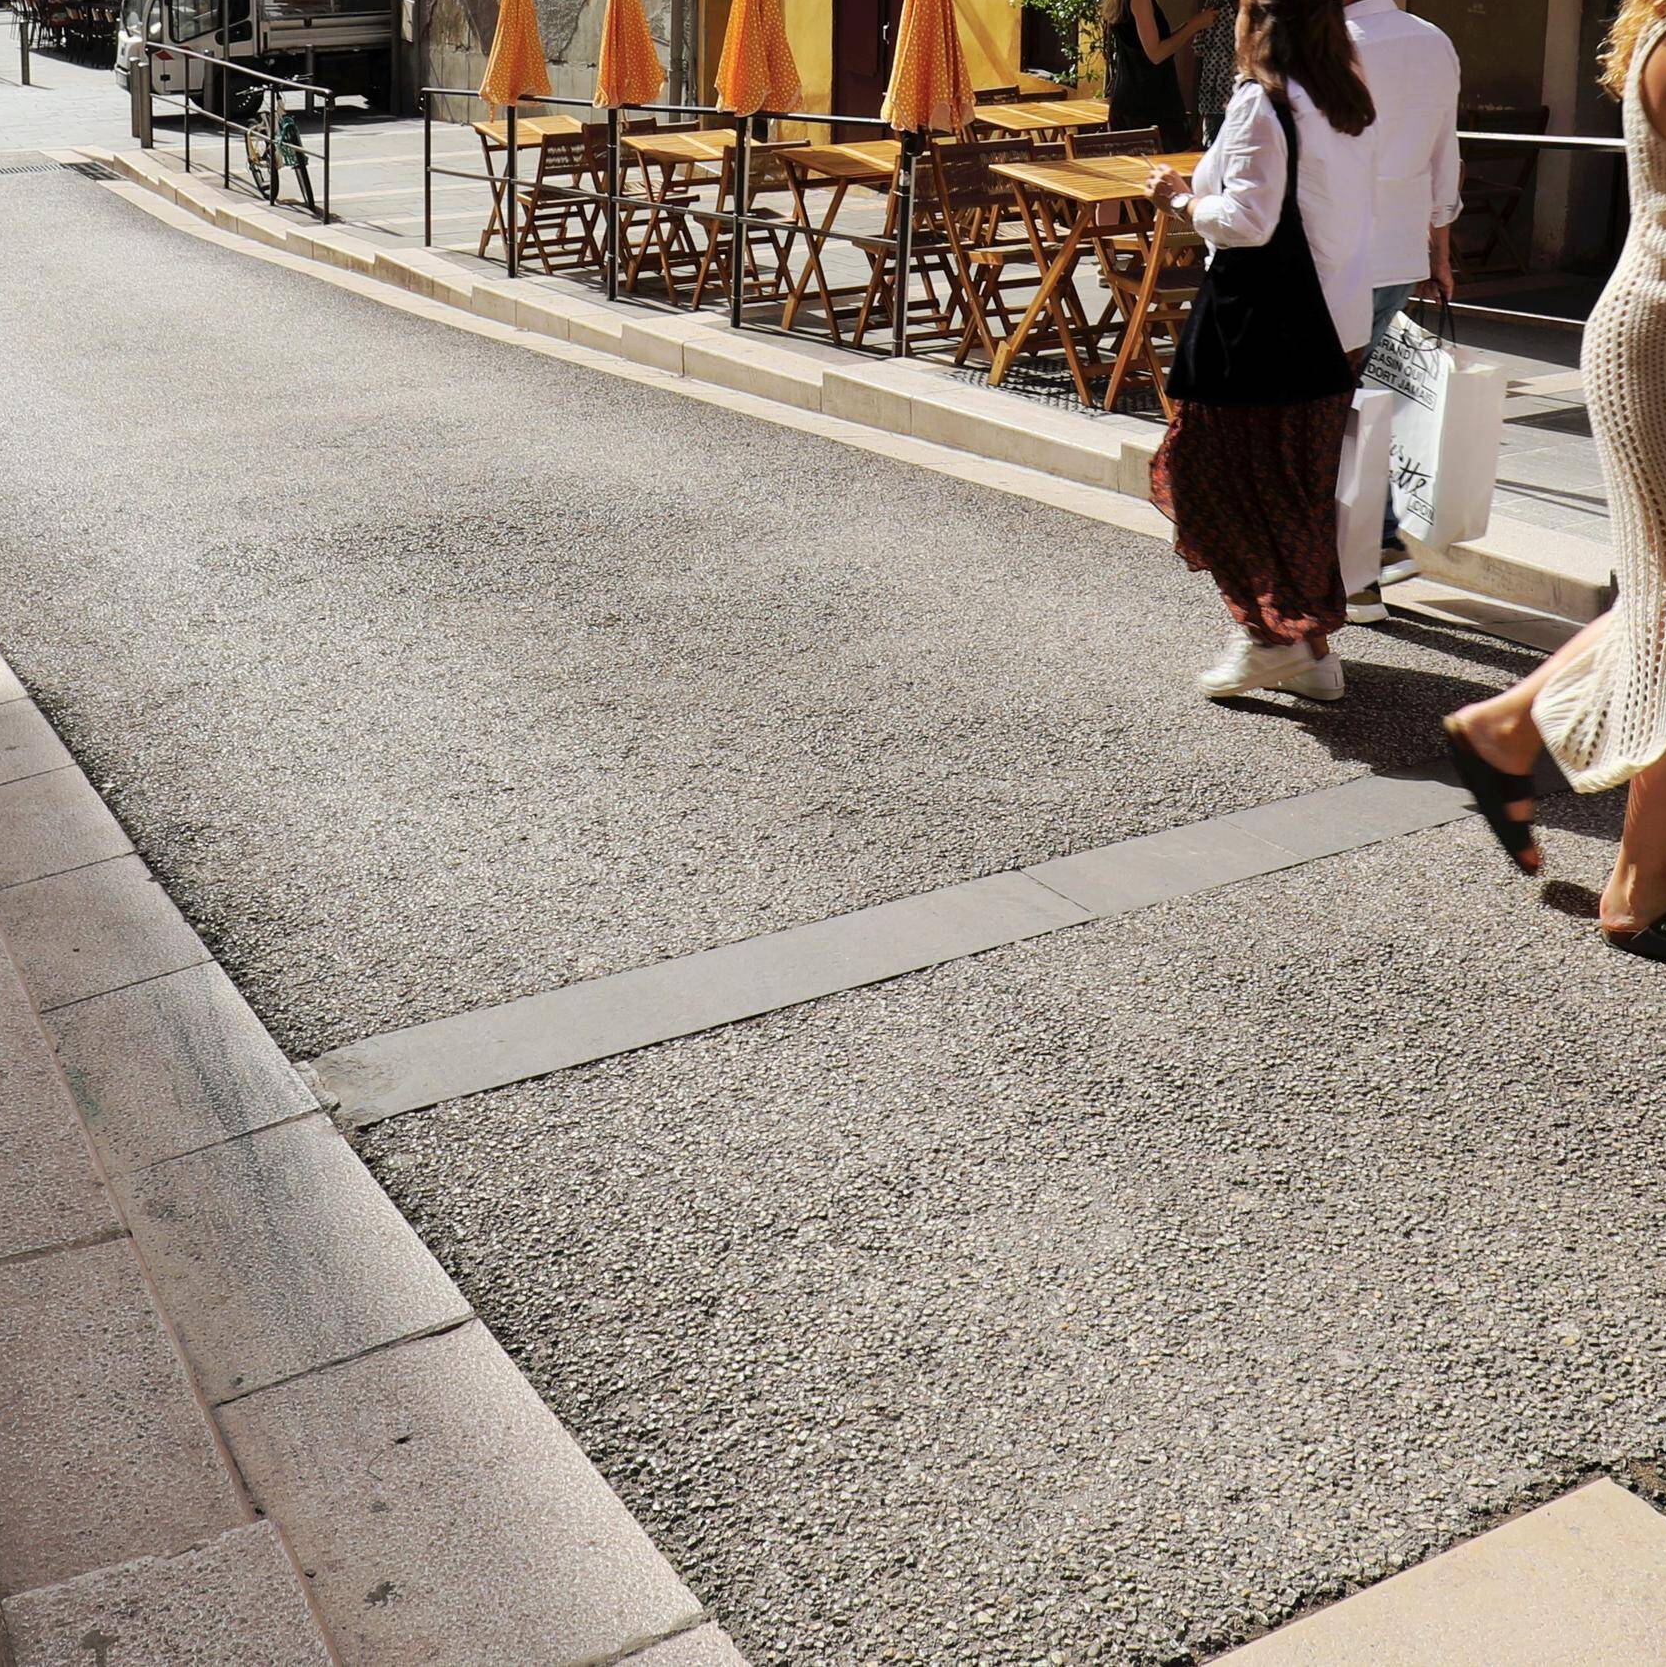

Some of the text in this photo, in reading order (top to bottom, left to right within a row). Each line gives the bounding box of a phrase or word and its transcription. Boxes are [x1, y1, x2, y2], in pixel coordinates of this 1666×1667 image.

[1377, 338, 1412, 360] RAND
[1370, 349, 1403, 372] GASIN
[1367, 363, 1398, 384] DORT
